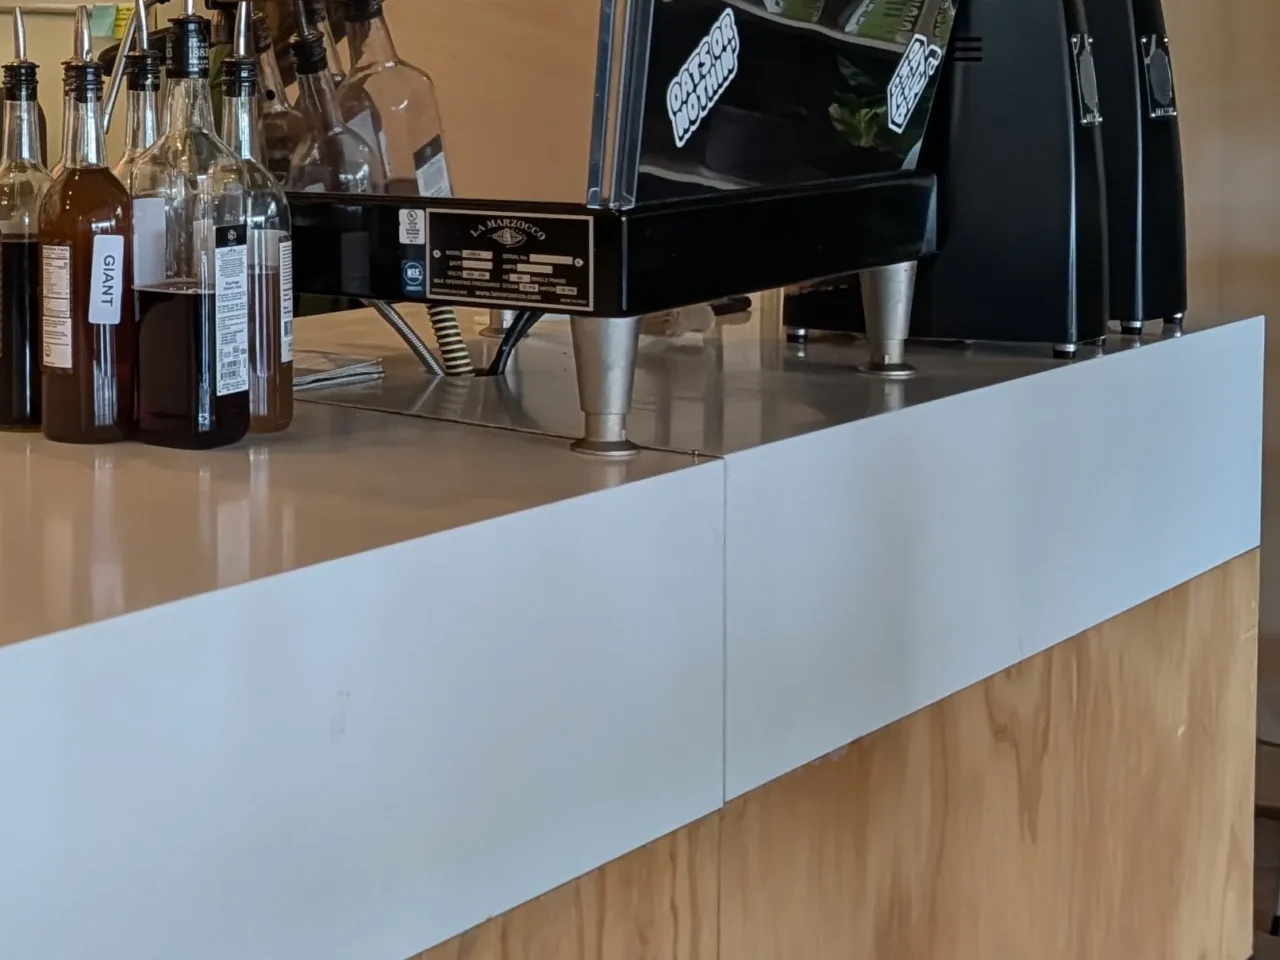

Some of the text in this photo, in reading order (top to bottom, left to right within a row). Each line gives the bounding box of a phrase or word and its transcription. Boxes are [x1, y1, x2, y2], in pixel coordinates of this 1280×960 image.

[670, 13, 734, 113] OATS OR
[470, 219, 546, 240] LA MARZOCCO
[100, 254, 116, 307] GIANT
[407, 268, 420, 279] NSF
